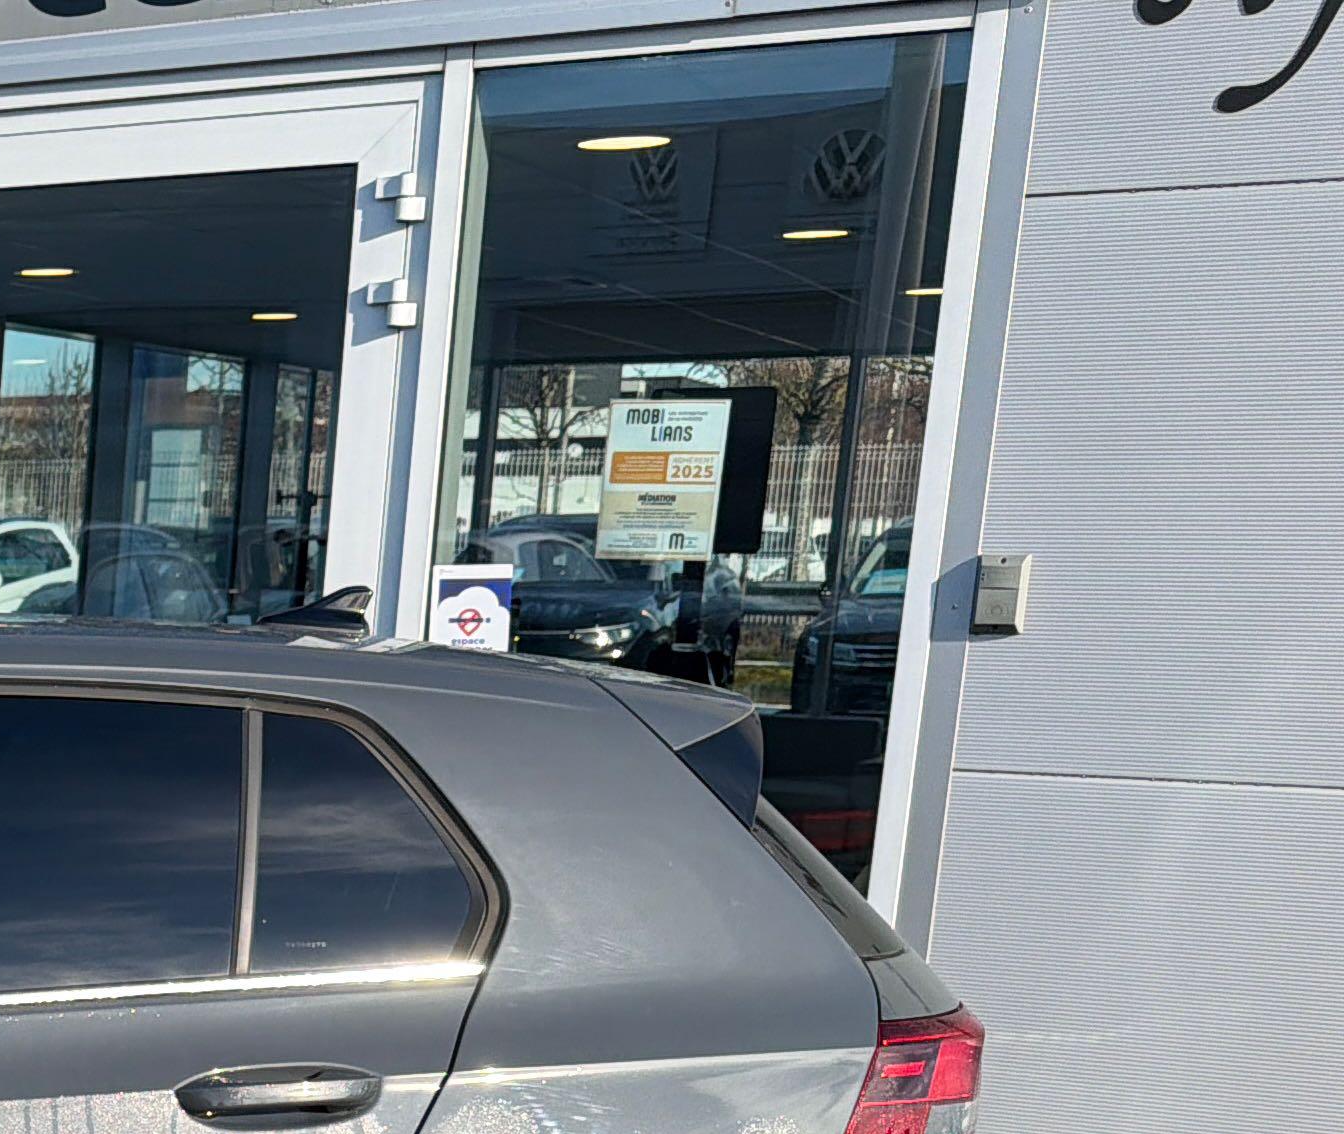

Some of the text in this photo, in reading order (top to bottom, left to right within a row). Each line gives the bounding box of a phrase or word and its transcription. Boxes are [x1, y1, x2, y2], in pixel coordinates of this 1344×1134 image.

[626, 408, 665, 424] MOBI
[651, 425, 693, 442] LIANS
[671, 464, 714, 478] 2025
